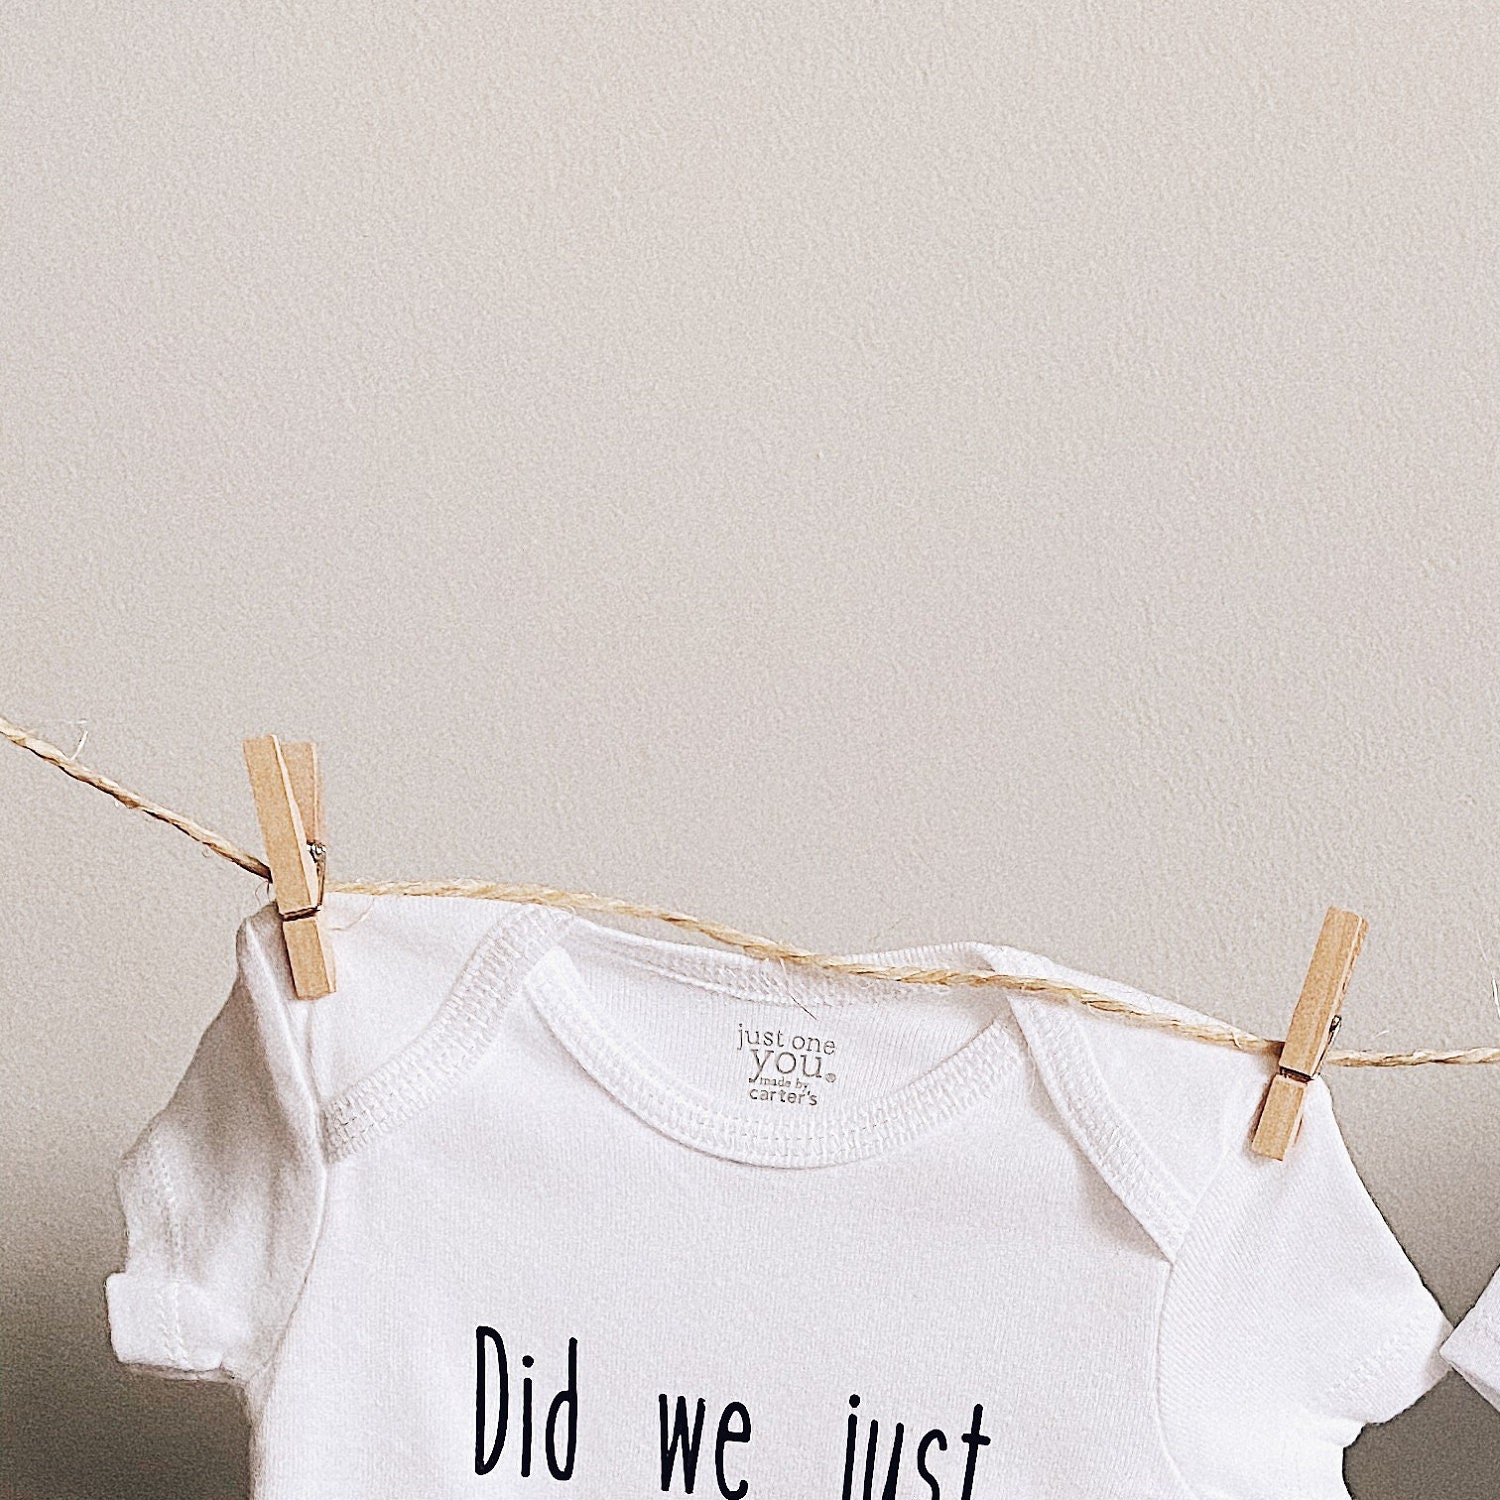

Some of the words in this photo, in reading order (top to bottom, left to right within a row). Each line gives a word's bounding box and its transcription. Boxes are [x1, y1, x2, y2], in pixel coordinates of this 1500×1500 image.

[737, 1023, 784, 1051] just
[792, 1035, 836, 1056] one
[749, 1088, 818, 1106] carter's
[474, 1325, 578, 1481] Did
[658, 1393, 752, 1500] we
